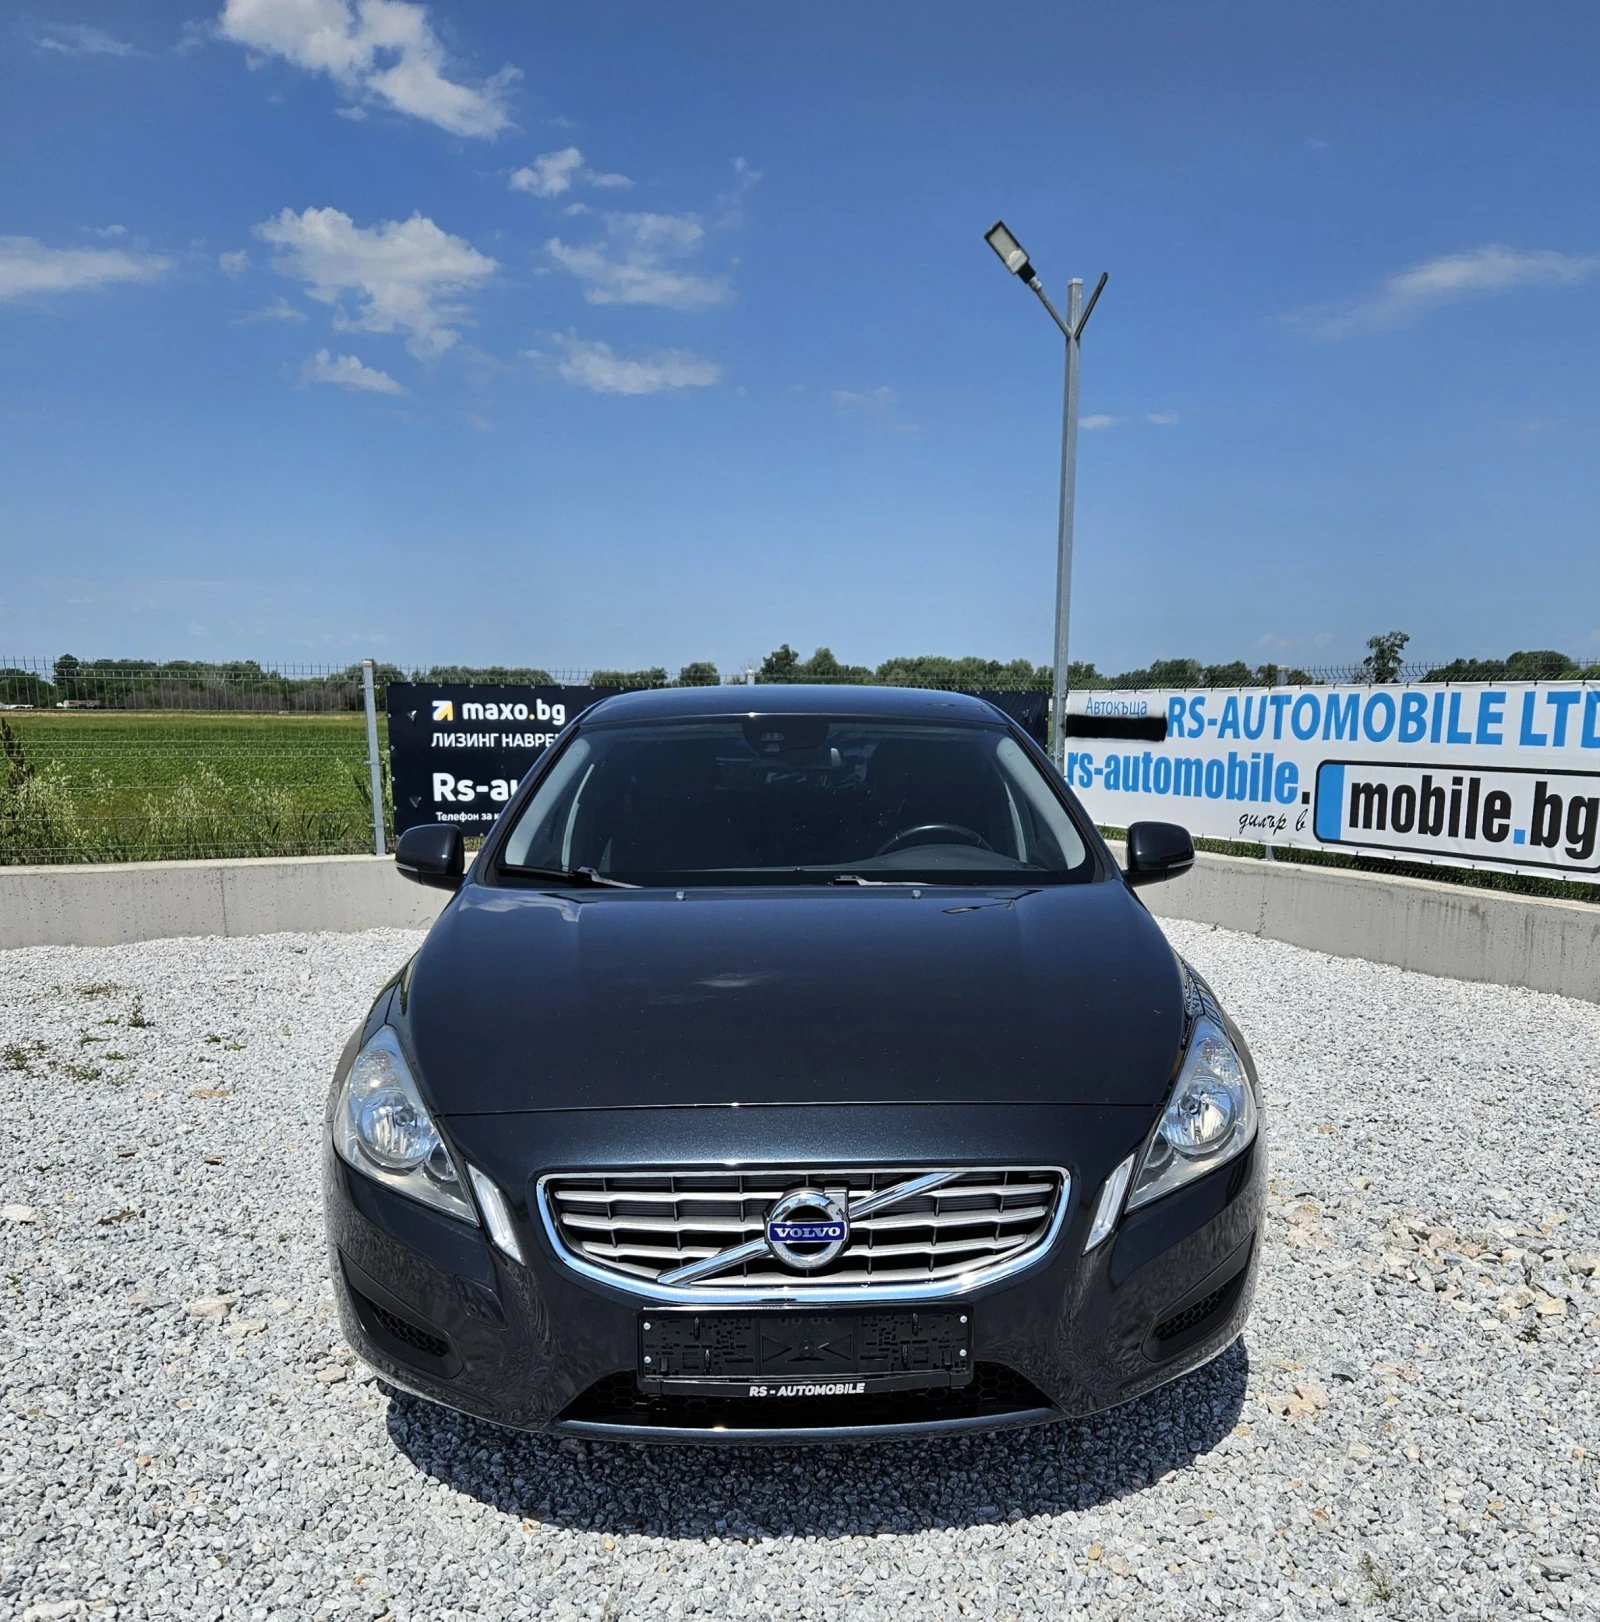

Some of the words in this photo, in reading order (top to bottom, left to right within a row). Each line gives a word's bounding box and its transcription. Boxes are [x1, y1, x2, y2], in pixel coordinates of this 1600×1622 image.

[461, 698, 566, 726] maxo.bg
[1085, 696, 1148, 718] Автокъща
[1167, 690, 1506, 746] RS-AUTOMOBILE
[431, 733, 499, 748] ЛИЗИНГ
[501, 733, 560, 748] НАВРЕ
[436, 812, 479, 823] Телефон
[481, 813, 493, 821] за
[1349, 774, 1600, 861] mobile.bg
[773, 1226, 841, 1239] VOLVO
[749, 1386, 768, 1397] RS
[777, 1382, 866, 1397] AUTOMOBILE
